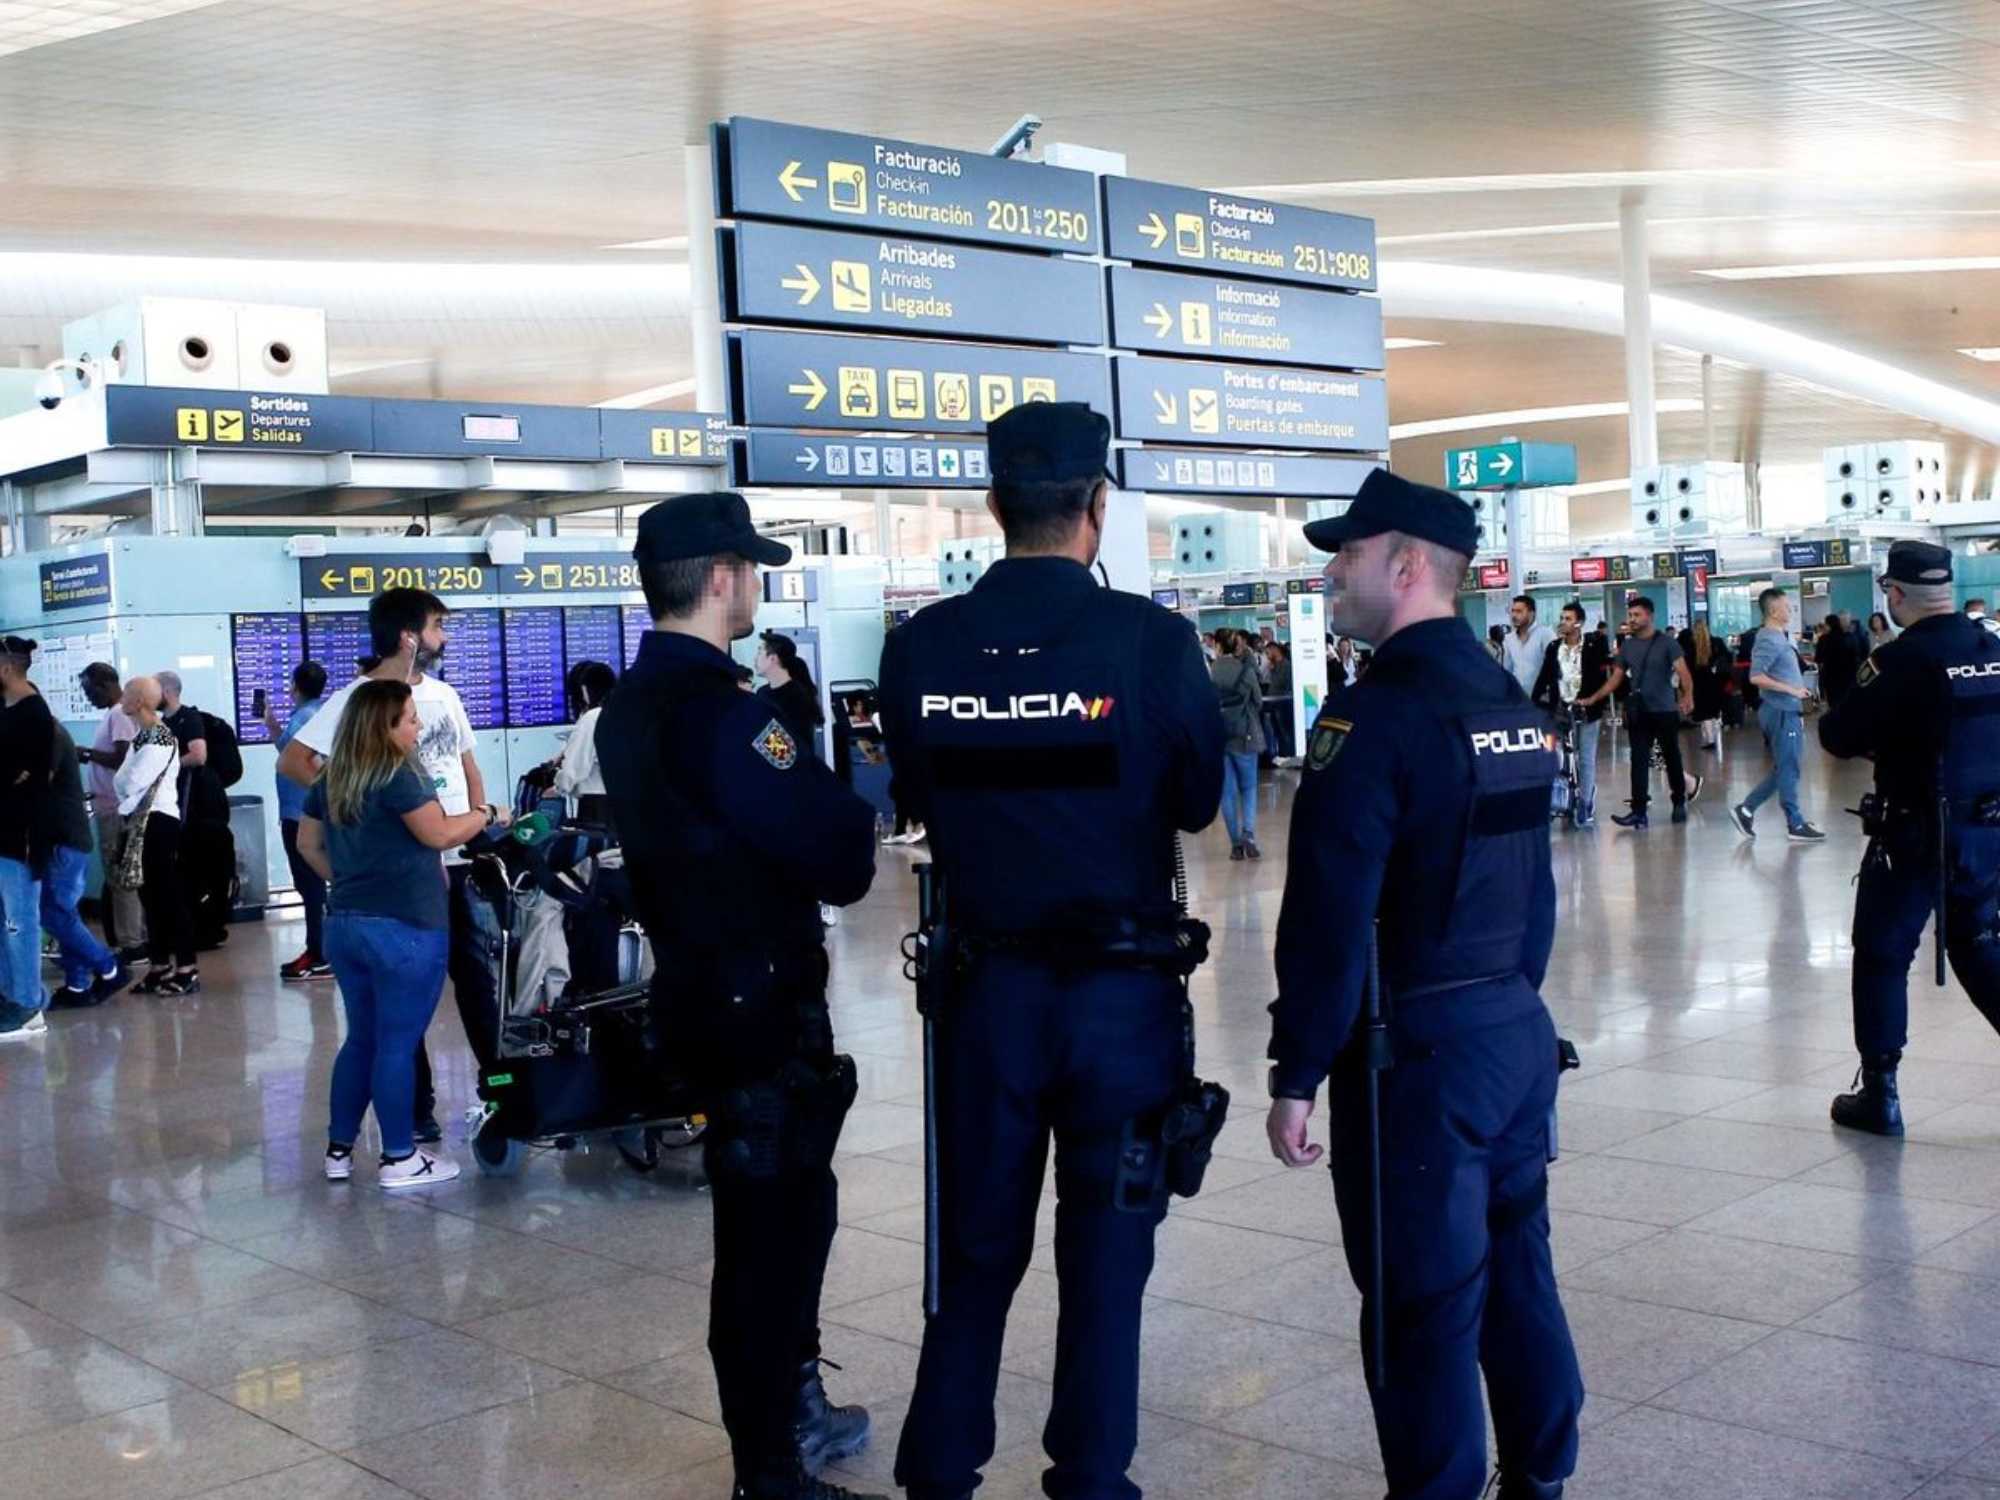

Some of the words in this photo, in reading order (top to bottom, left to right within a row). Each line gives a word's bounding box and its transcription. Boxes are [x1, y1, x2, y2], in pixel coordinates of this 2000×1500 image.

[874, 145, 961, 176] Facturació
[876, 171, 930, 195] Check-in
[877, 196, 973, 227] Facturación
[987, 200, 1032, 235] 201
[1043, 209, 1088, 242] 250
[1209, 198, 1275, 225] Facturació
[879, 242, 956, 270] Arribades
[1213, 243, 1284, 268] Facturación
[881, 268, 933, 290] Arrivals
[882, 293, 953, 319] Llegadas
[1216, 285, 1281, 306] Informació
[1219, 328, 1291, 351] Información
[846, 370, 871, 382] TAXI
[1224, 370, 1264, 391] Portes
[1268, 374, 1360, 398] d'embarcament
[250, 397, 309, 412] Sortides
[1226, 394, 1273, 414] Boarding
[1275, 398, 1304, 415] gates
[251, 413, 312, 428] Departures
[1227, 416, 1275, 434] Puertas
[1278, 419, 1294, 434] de
[1298, 421, 1355, 439] embarque
[252, 428, 302, 442] Salidas
[382, 567, 428, 589] 201
[437, 567, 483, 590] 250
[569, 566, 610, 587] 251
[921, 692, 1089, 719] POLICIA
